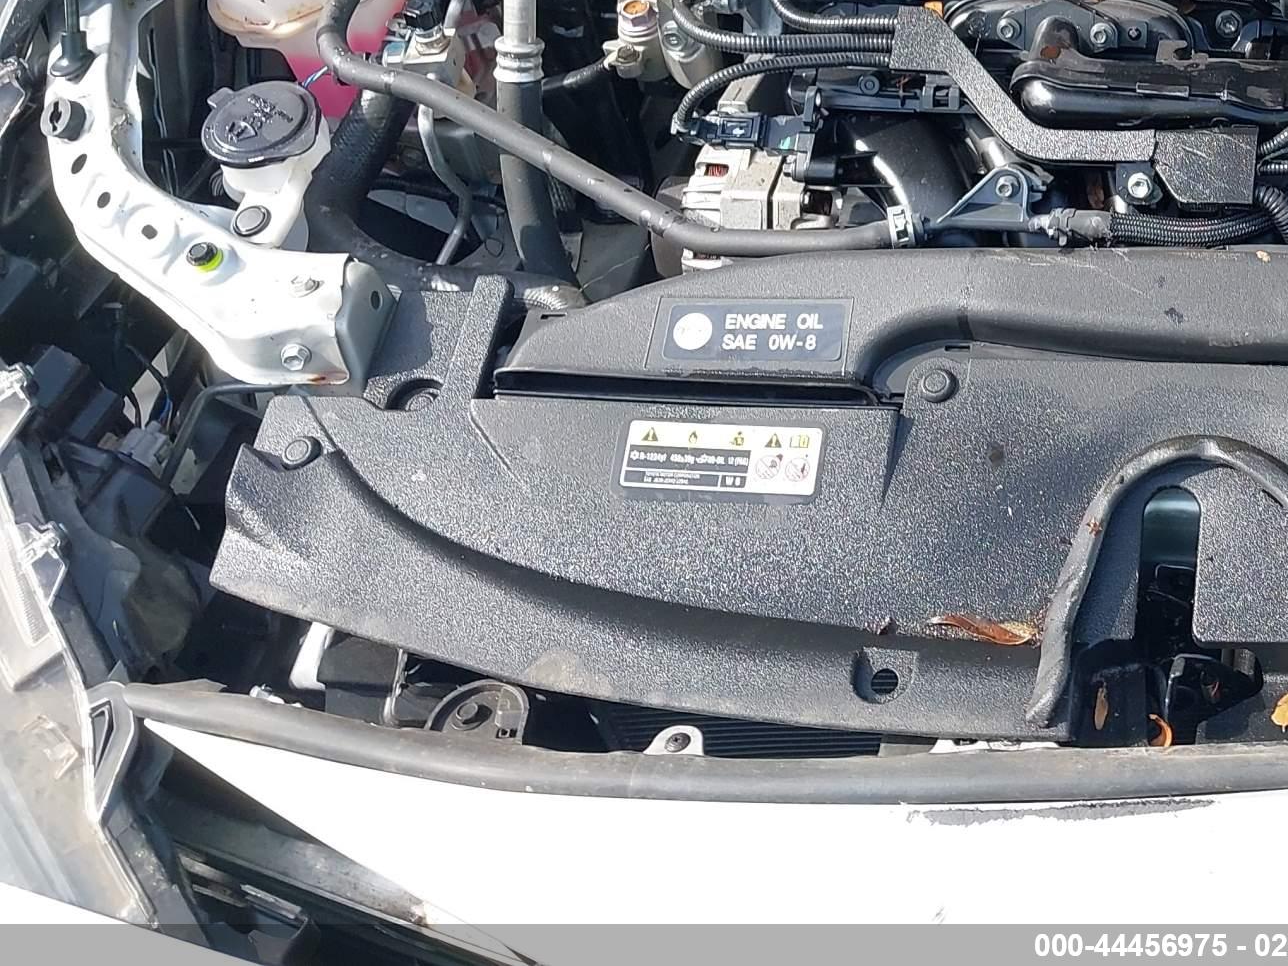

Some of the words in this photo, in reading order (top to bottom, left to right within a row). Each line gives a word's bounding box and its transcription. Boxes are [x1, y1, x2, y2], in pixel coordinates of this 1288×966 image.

[724, 313, 787, 330] ENGINE
[796, 313, 824, 330] OIL
[721, 333, 758, 351] SAE
[768, 334, 817, 351] 0W-8
